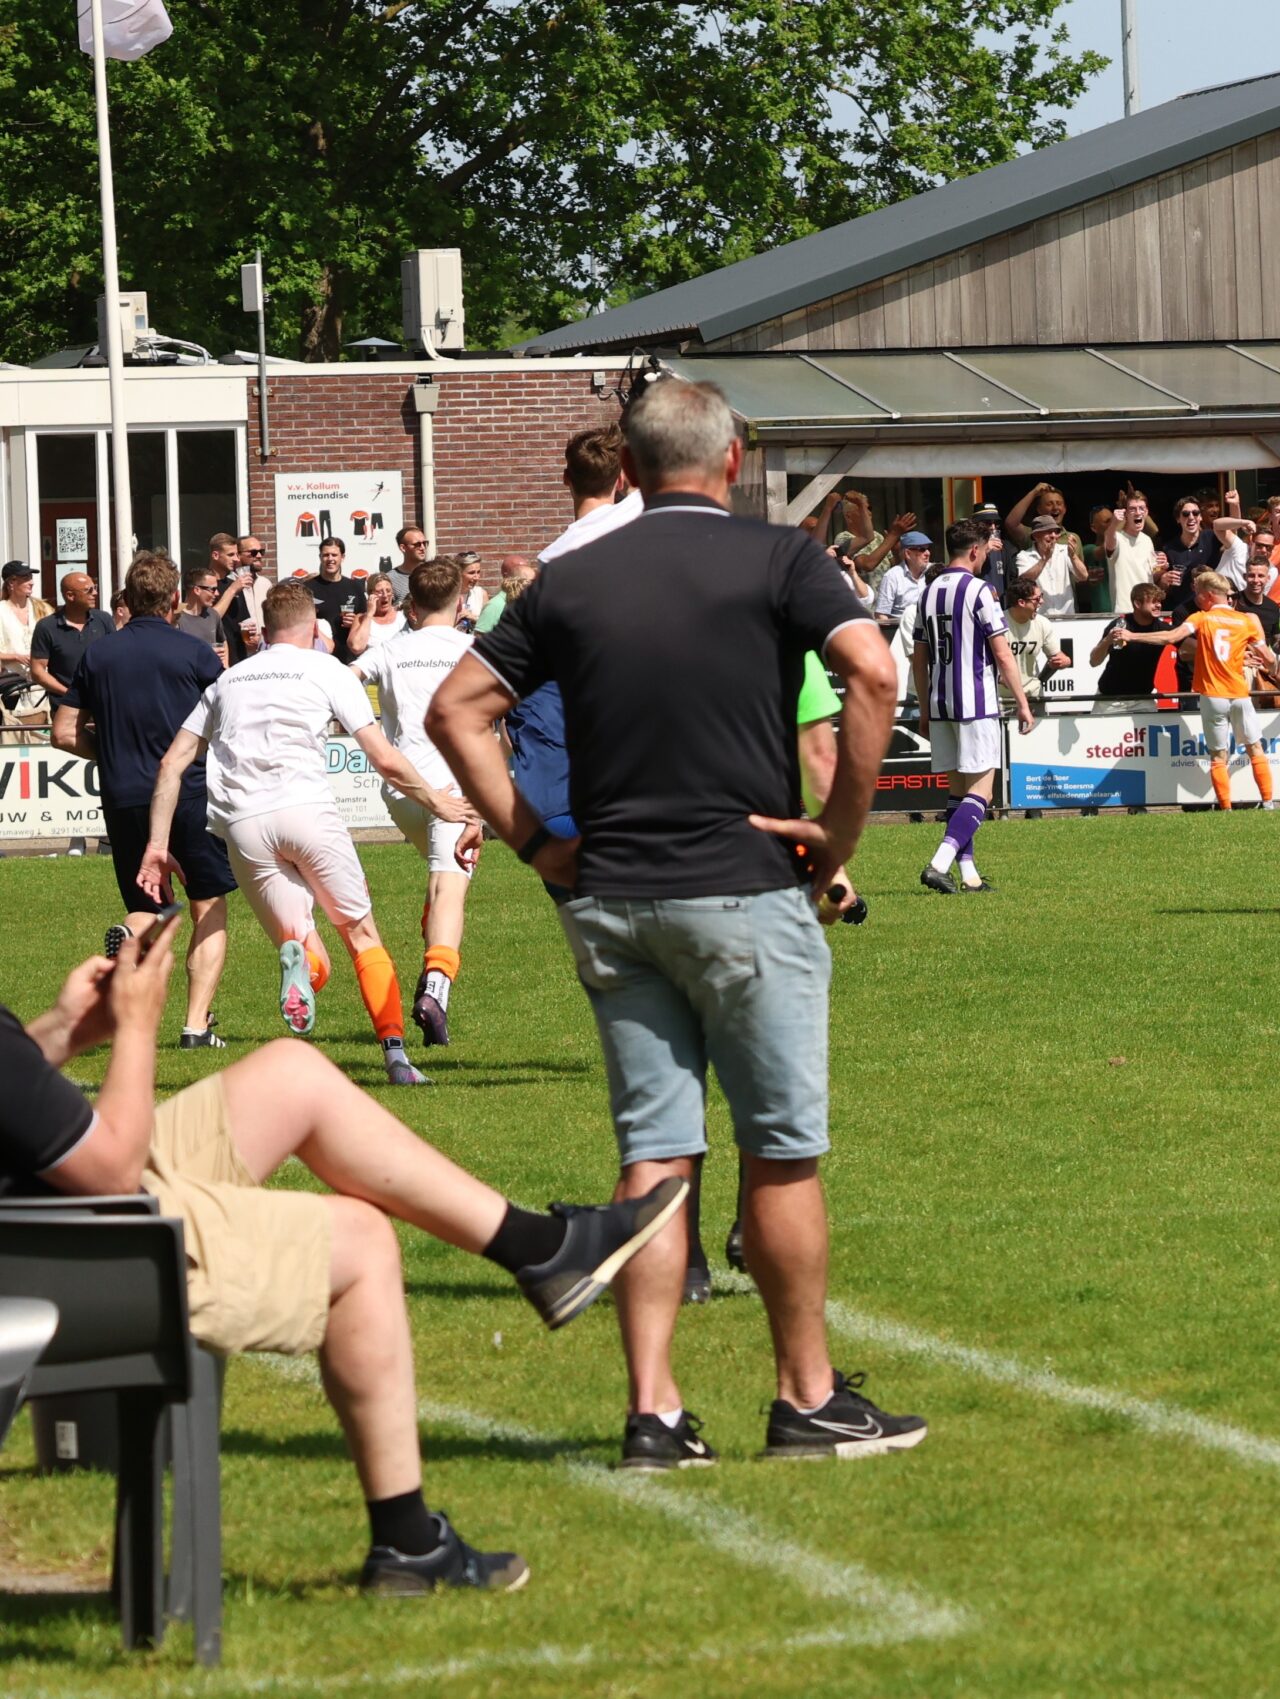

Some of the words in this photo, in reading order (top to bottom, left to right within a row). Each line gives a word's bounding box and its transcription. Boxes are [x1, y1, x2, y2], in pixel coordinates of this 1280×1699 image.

[307, 482, 340, 491] Kollum
[287, 491, 349, 500] merchandise
[926, 614, 953, 665] 15
[1213, 628, 1231, 661] 6
[1007, 641, 1037, 655] 977
[228, 671, 304, 684] voetbalshop.nl
[1124, 727, 1147, 742] elf
[1086, 743, 1145, 758] steden
[1171, 758, 1195, 768] advies
[875, 774, 951, 789] ERSTE
[40, 811, 52, 822] &
[66, 809, 99, 821] MO
[0, 829, 35, 837] rsmaweg
[51, 826, 70, 835] 9291
[72, 826, 83, 834] NC
[86, 825, 107, 833] Kollu
